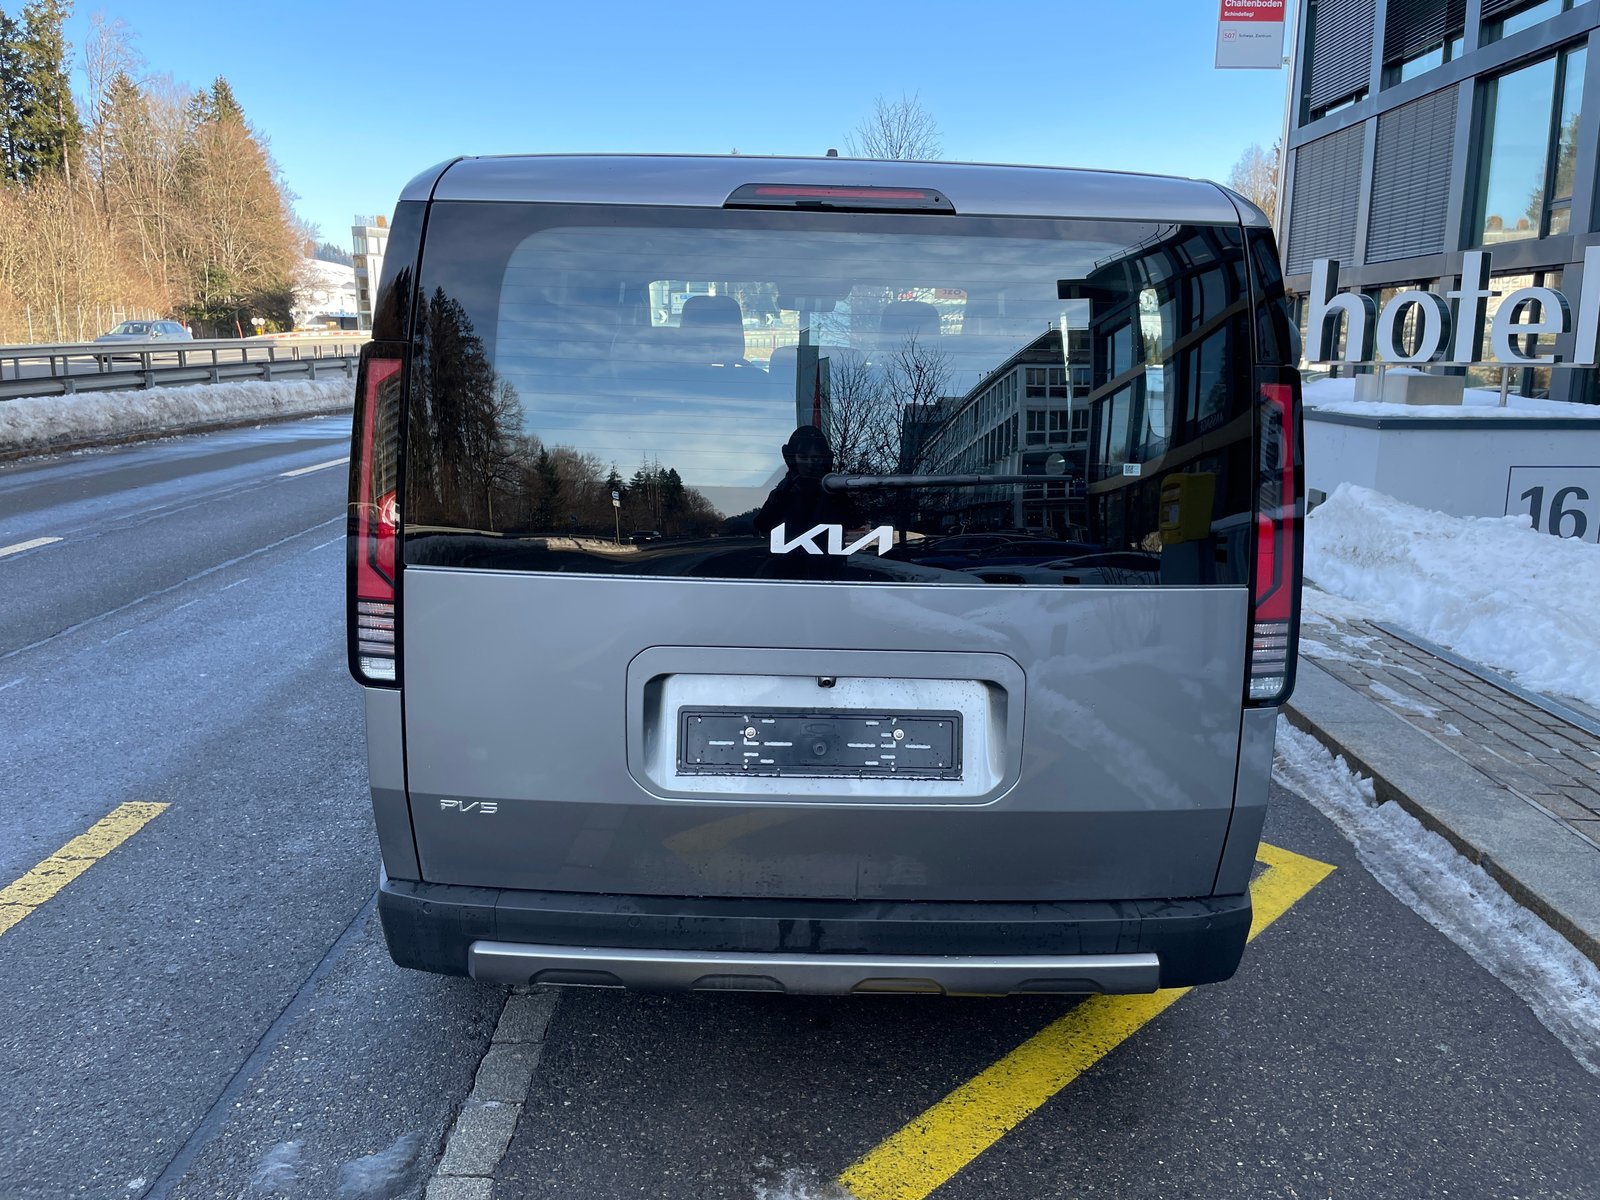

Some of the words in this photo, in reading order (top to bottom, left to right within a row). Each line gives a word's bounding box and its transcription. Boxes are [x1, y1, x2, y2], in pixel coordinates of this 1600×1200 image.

[1305, 246, 1600, 364] hotel
[770, 522, 894, 556] KIA
[1520, 486, 1589, 539] 16
